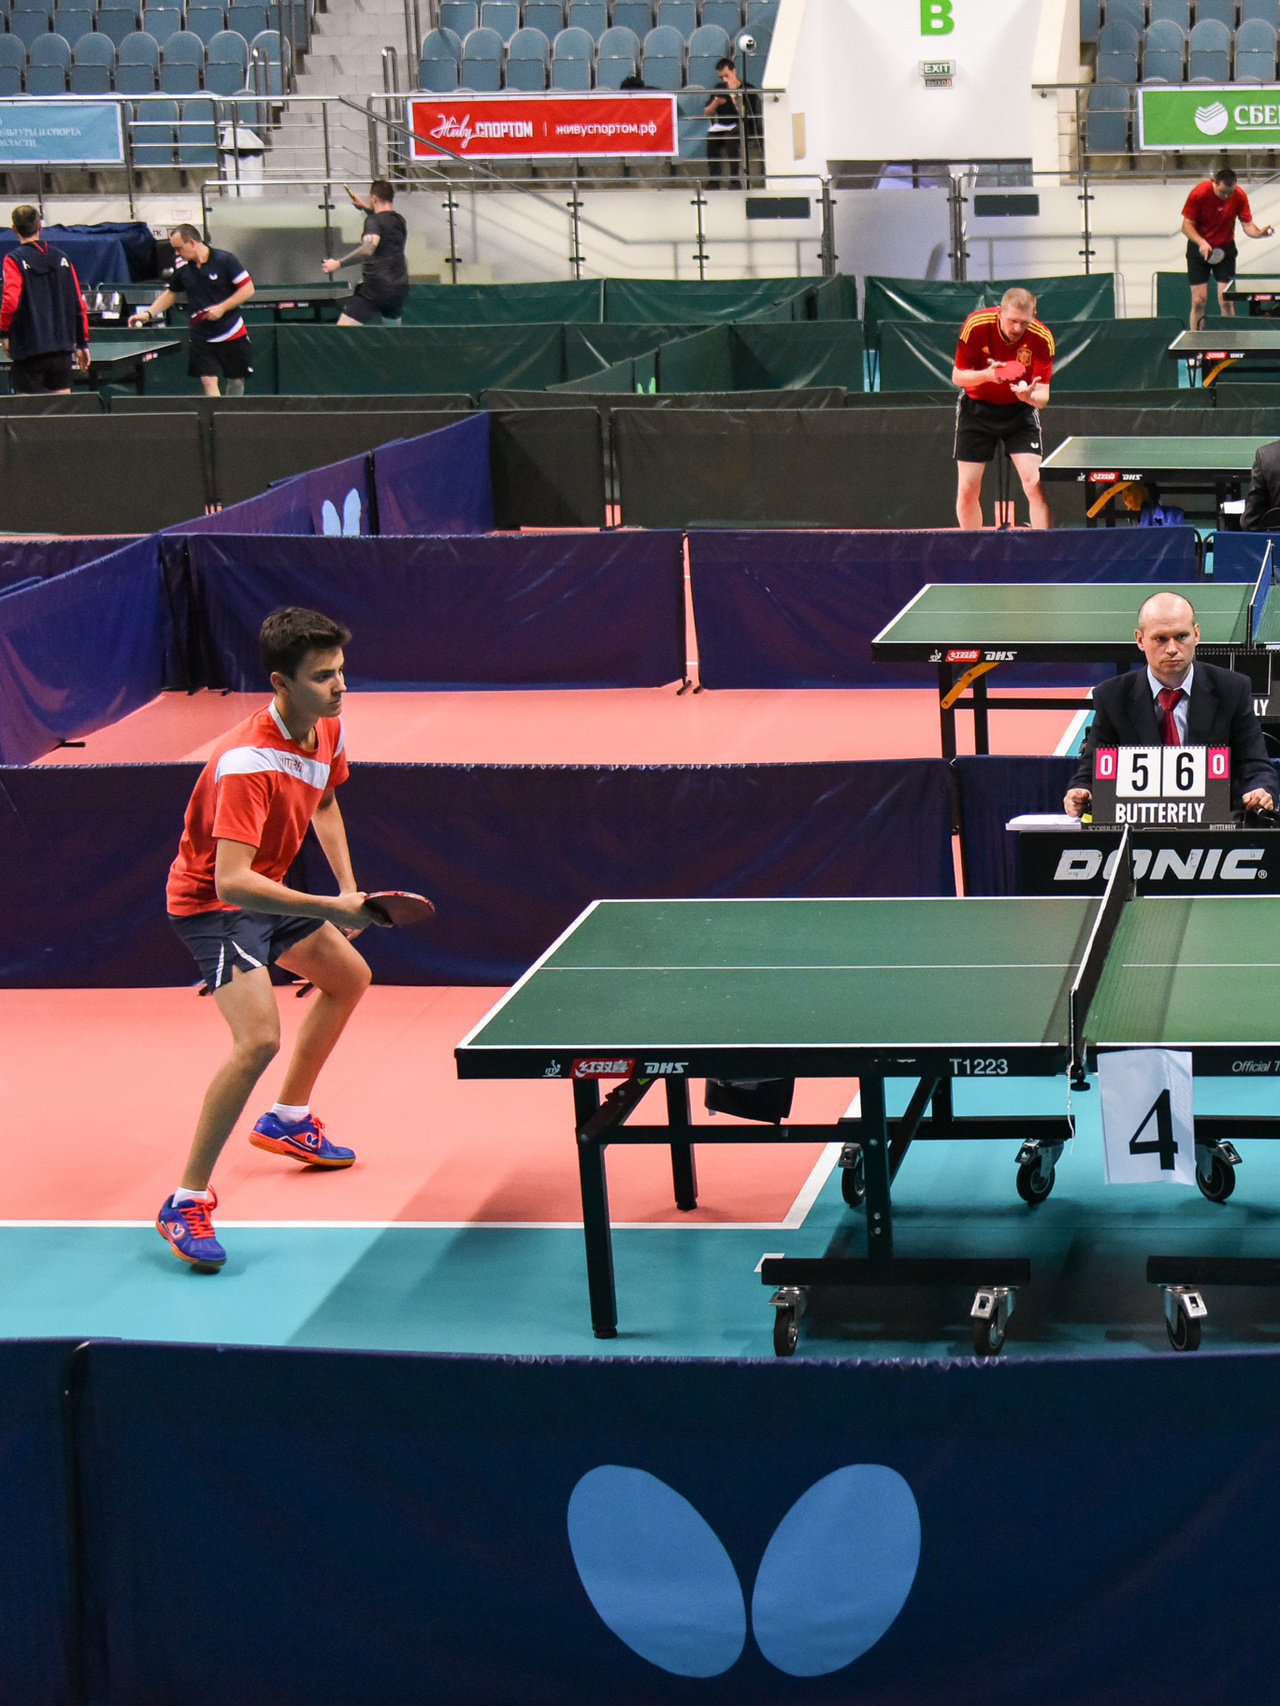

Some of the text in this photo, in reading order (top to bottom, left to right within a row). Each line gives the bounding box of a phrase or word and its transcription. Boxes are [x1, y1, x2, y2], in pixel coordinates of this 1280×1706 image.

[920, 0, 955, 35] B
[925, 64, 950, 73] EXIT
[0, 127, 37, 136] УЛЬТУРЫ
[430, 113, 475, 149] Живу
[476, 121, 533, 138] СПОРТОМ
[556, 120, 657, 137] живуспортом.рф
[984, 651, 1018, 661] DHS
[1101, 752, 1225, 791] 0 5 6 0
[1115, 803, 1205, 824] BUTTERFLY
[1053, 849, 1266, 881] DONIC
[644, 1062, 689, 1074] DHS
[949, 1058, 1009, 1075] T1223
[1231, 1060, 1271, 1073] Official
[1129, 1088, 1179, 1171] 4
